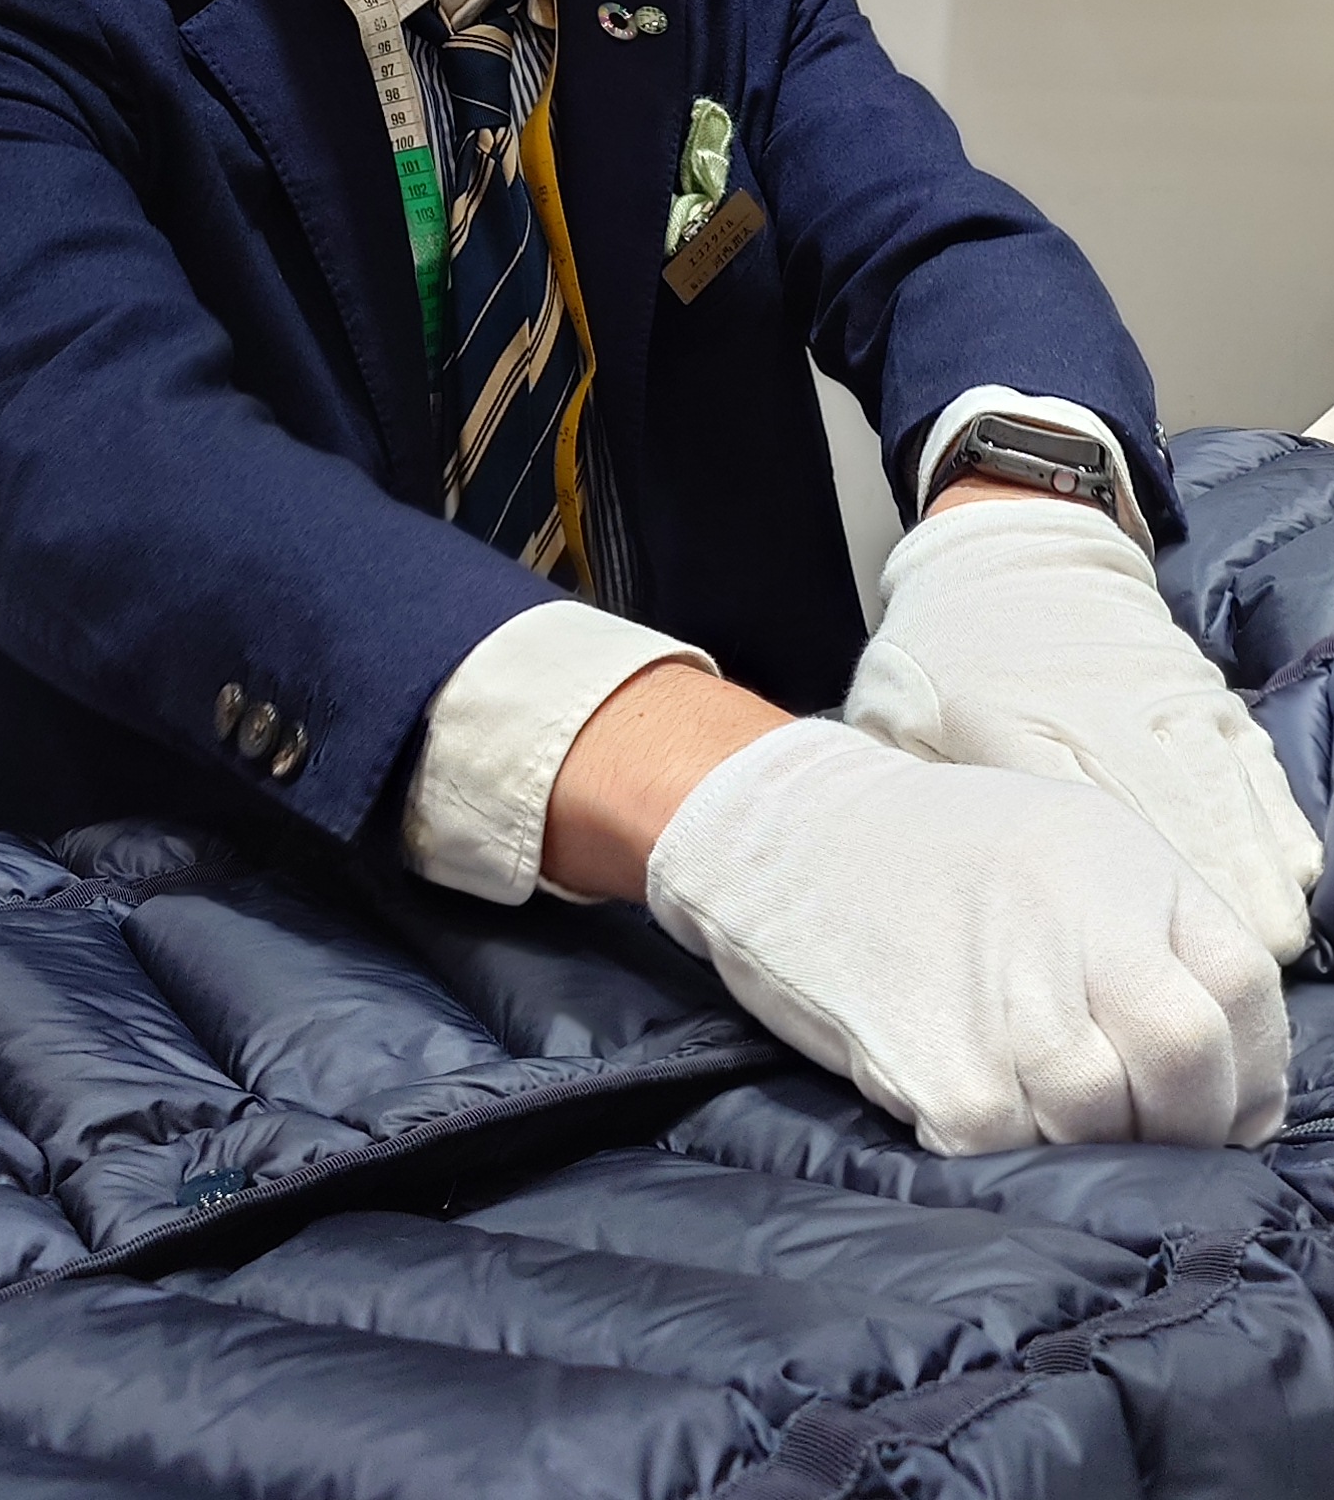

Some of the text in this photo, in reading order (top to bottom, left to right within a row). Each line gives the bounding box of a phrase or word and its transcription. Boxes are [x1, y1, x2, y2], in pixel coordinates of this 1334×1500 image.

[373, 16, 388, 31] 95
[378, 40, 392, 54] 96
[380, 63, 395, 78] 97
[385, 87, 401, 102] 98
[390, 111, 407, 126] 99
[395, 134, 415, 151] 100
[401, 159, 421, 174] 101
[408, 183, 428, 197] 102
[415, 206, 435, 222] 103
